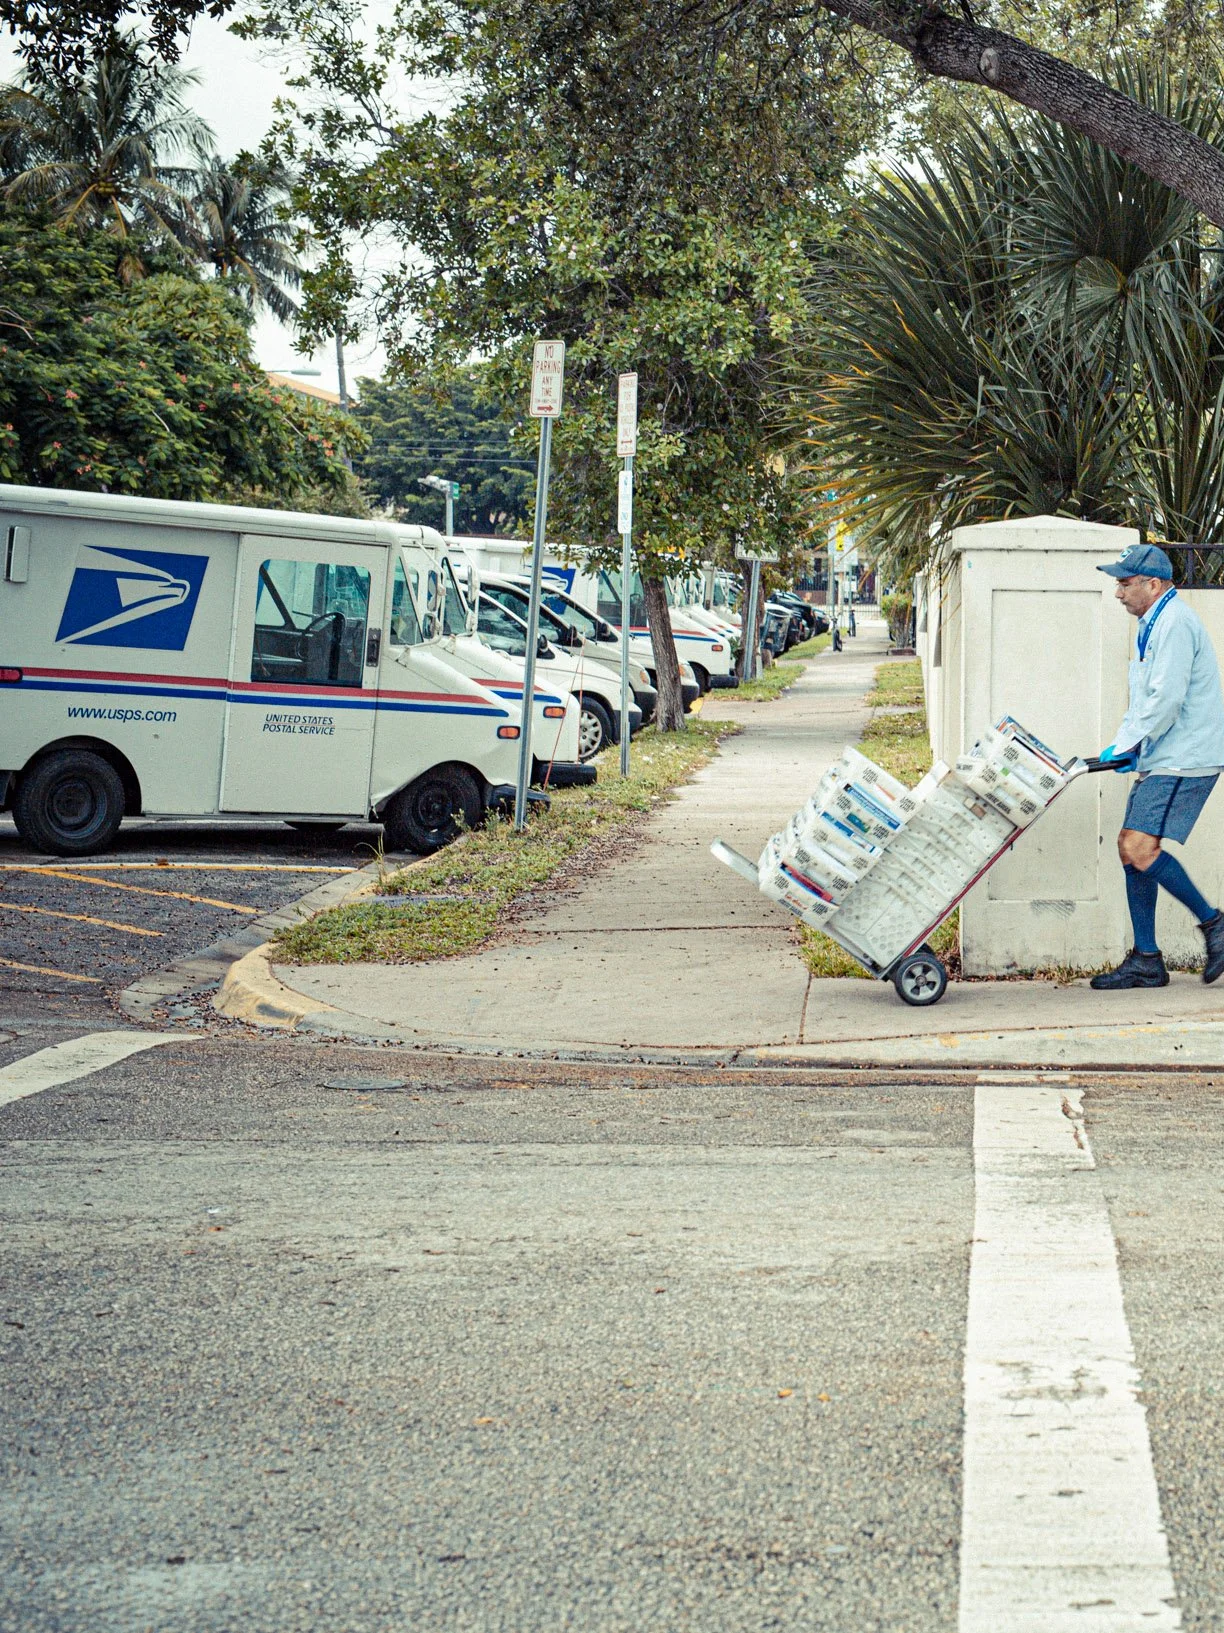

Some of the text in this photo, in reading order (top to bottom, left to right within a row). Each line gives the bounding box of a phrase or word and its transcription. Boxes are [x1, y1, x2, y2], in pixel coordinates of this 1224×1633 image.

[544, 345, 554, 359] NO
[536, 360, 561, 374] PARKING
[542, 375, 553, 386] ANY
[67, 707, 177, 723] www.usps.com
[265, 713, 334, 725] UNITED STATES
[262, 723, 336, 736] POSTAL SERVICE
